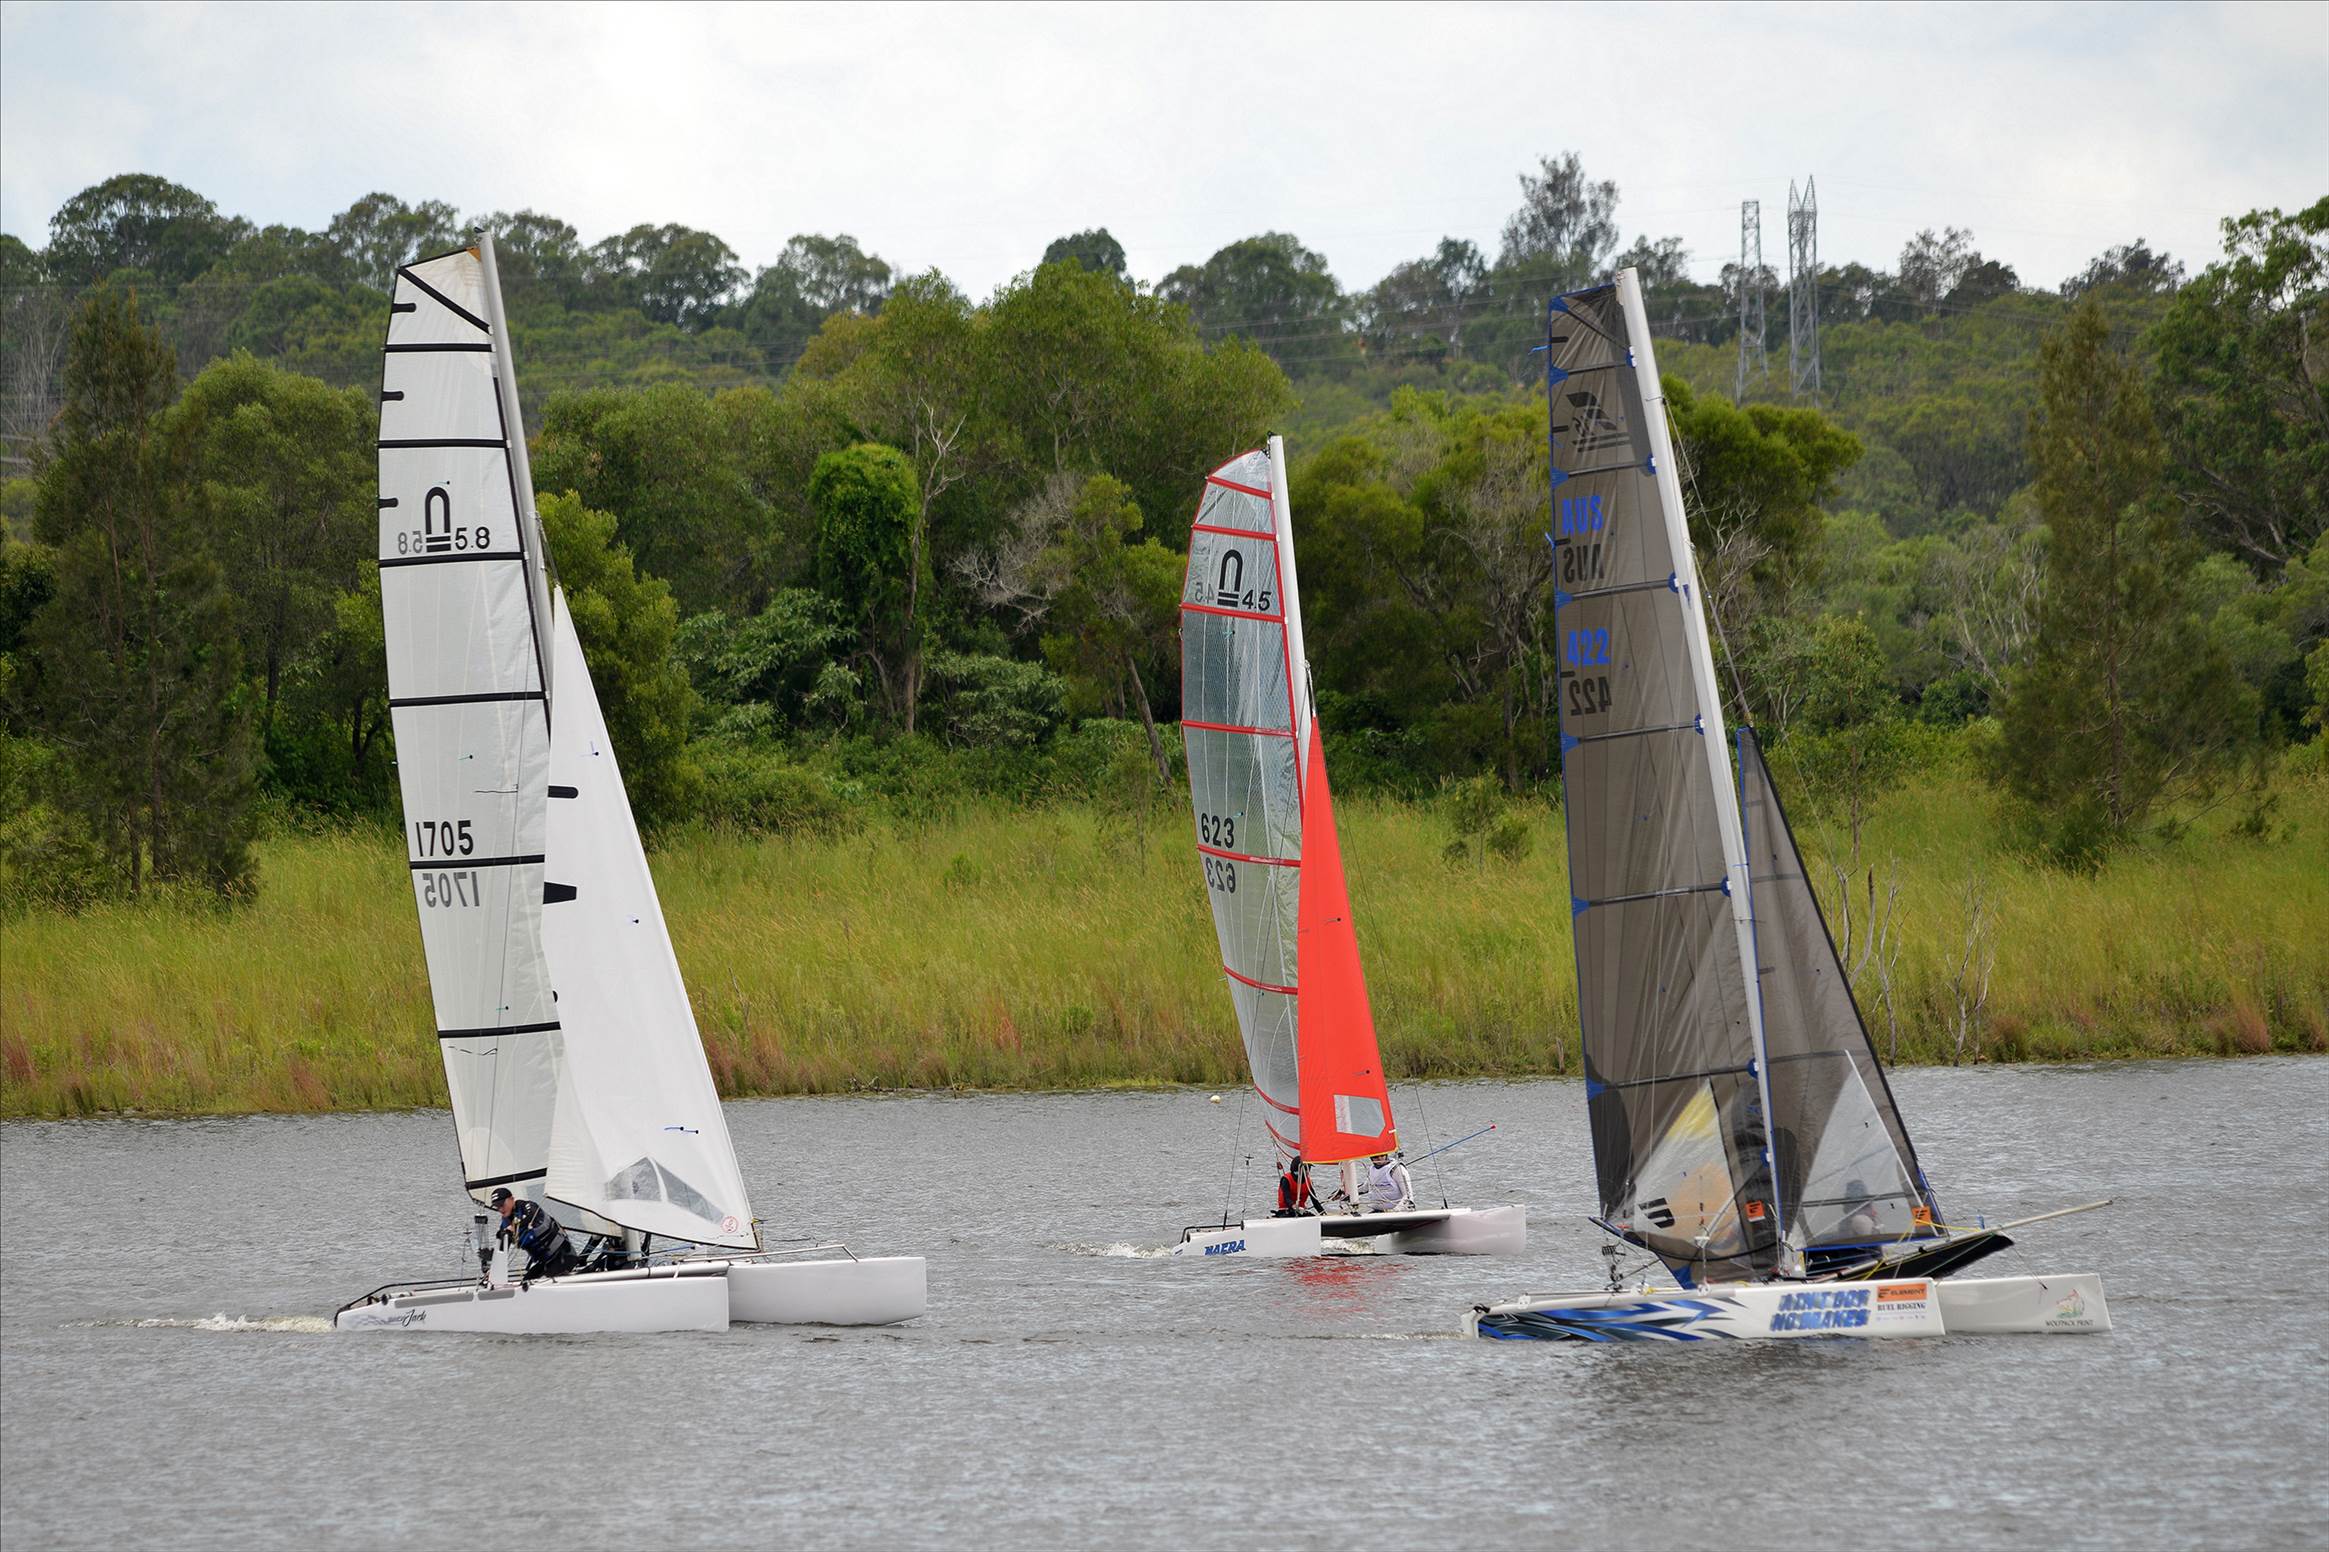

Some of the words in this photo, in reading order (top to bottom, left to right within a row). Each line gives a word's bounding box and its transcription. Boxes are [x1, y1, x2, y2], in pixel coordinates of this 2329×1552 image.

[1561, 496, 1604, 537] AUS
[455, 526, 490, 551] 5.8
[1242, 589, 1272, 612] 4.5
[1567, 626, 1610, 669] 422
[415, 819, 474, 857] 1705
[1201, 812, 1235, 849] 623
